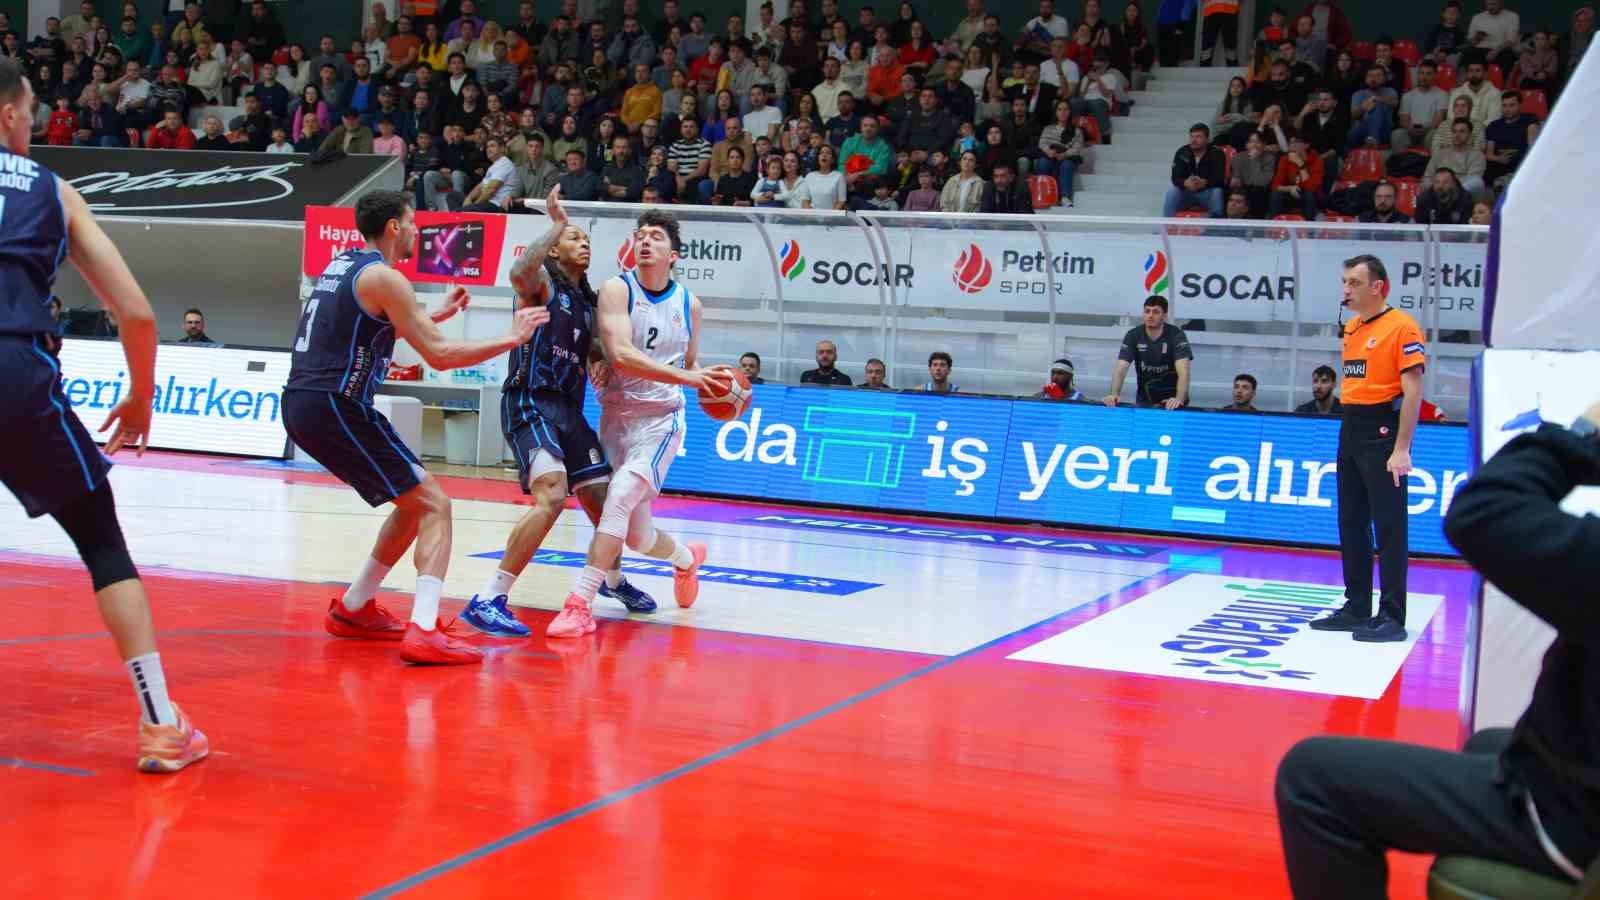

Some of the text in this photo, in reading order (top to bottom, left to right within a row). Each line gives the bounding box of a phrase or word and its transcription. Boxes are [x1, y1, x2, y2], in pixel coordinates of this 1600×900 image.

[679, 239, 742, 261] etkim
[1001, 249, 1095, 275] Petkim
[811, 260, 915, 288] SOCAR
[999, 280, 1064, 296] SPOR
[1179, 272, 1296, 301] SOCAR
[295, 299, 319, 352] 3
[646, 327, 658, 350] 2
[715, 407, 797, 466] da
[921, 420, 988, 497] iş
[1018, 435, 1173, 501] yeri
[756, 515, 1098, 552] MEDICANA
